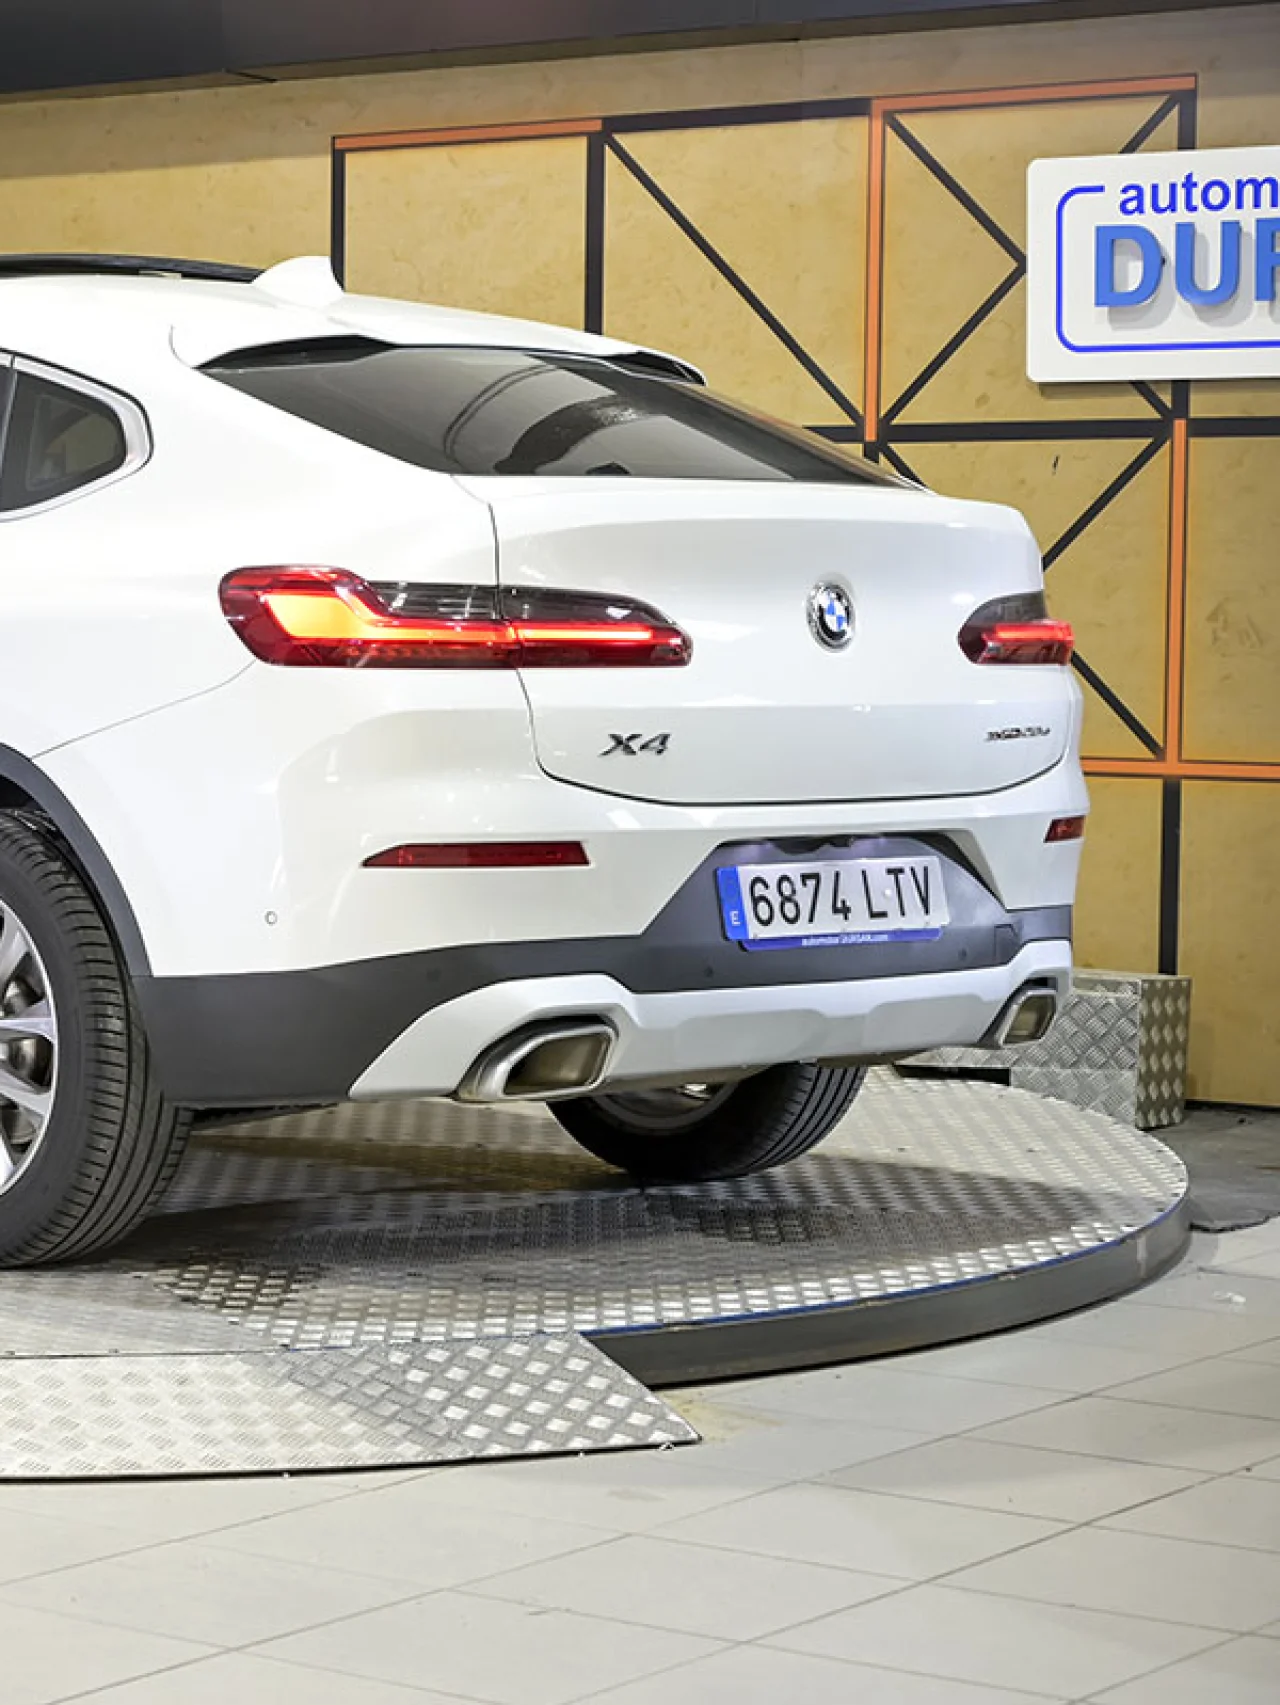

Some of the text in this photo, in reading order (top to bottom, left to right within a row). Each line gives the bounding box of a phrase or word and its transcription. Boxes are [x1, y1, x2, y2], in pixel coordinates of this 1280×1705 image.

[598, 732, 671, 757] X4
[749, 865, 930, 927] 6874 LTV
